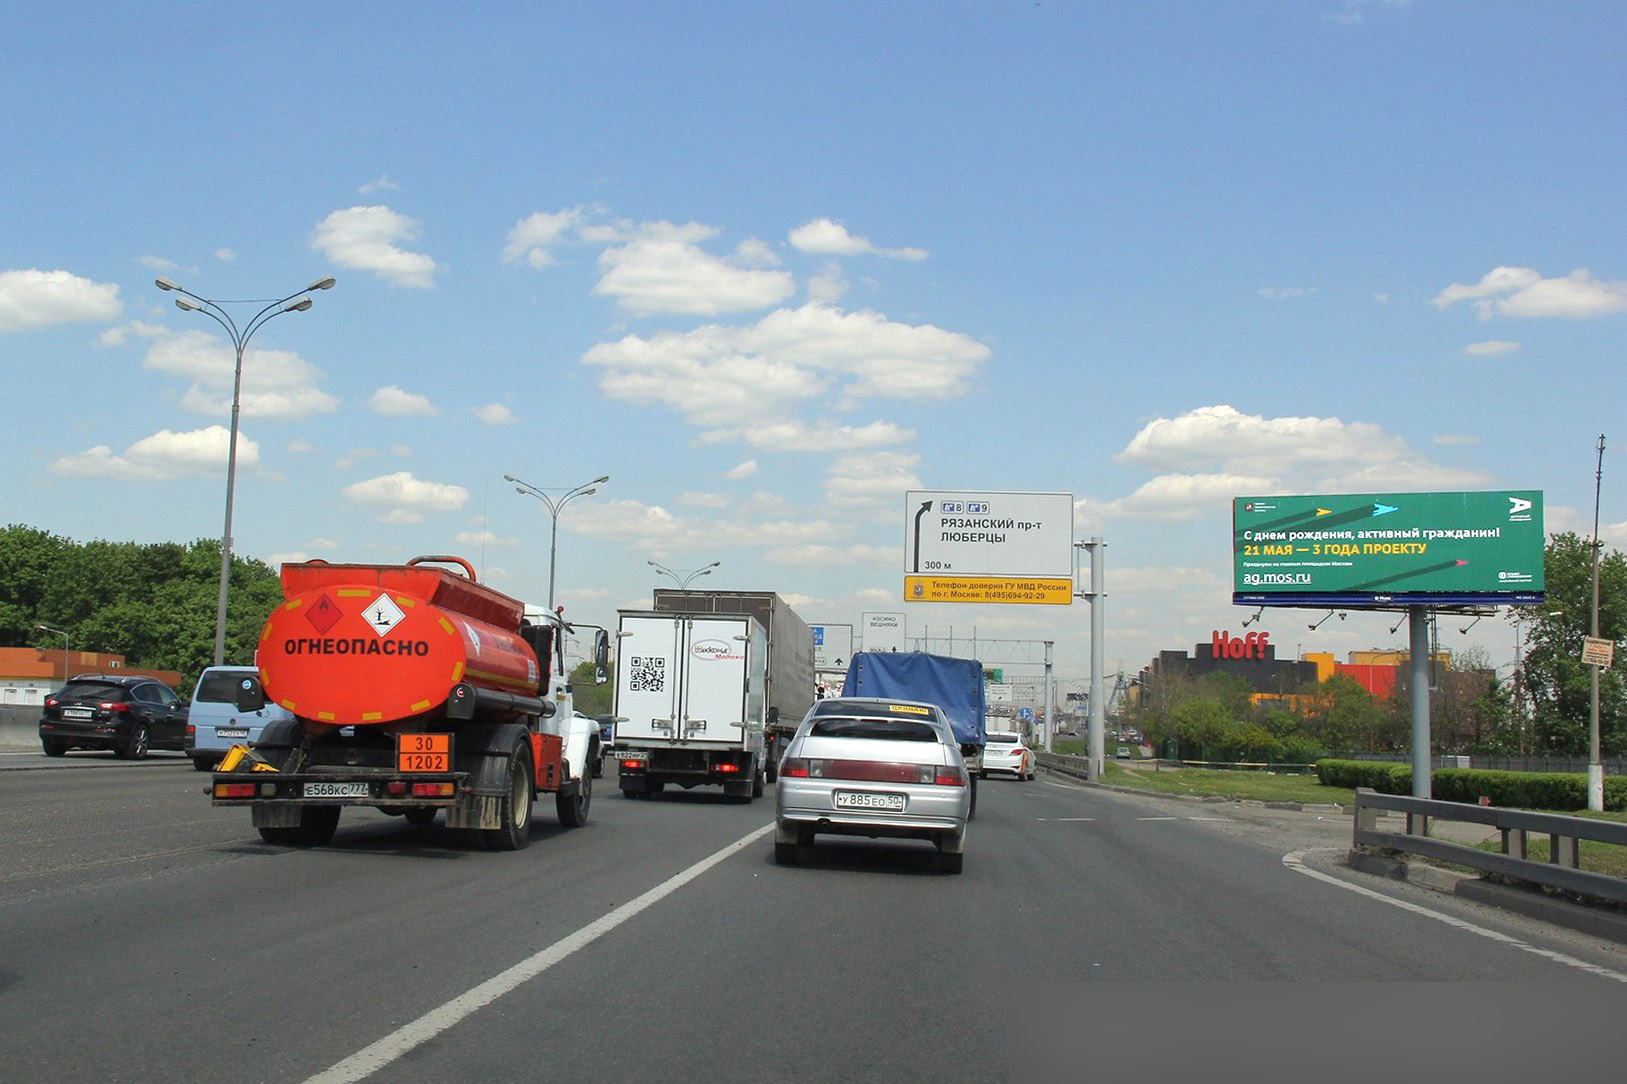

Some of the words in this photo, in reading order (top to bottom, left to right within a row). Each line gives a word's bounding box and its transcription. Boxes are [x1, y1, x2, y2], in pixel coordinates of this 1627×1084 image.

[956, 504, 962, 512] 8
[981, 504, 988, 513] 9
[941, 518, 1014, 529] РЯЗАНСКИЙ
[1017, 522, 1042, 531] пр-т
[941, 532, 1006, 544] ЛЮБЕРЦЫ
[1254, 532, 1286, 541] днем
[1289, 531, 1355, 542] рождения,
[1358, 529, 1419, 540] активный
[1423, 527, 1500, 540] гражданин!
[1244, 545, 1259, 556] 21
[1263, 545, 1293, 555] МАЯ
[1313, 544, 1321, 555] 3
[1325, 543, 1360, 556] ГОДА
[1363, 543, 1427, 555] ПРОЕКТУ
[925, 561, 941, 570] 300
[1243, 573, 1311, 585] ag.mos.ru
[932, 581, 967, 589] Телефон
[1017, 583, 1036, 591] МВД
[985, 592, 1045, 600] 8(495)694-92-29
[284, 638, 429, 656] ОГНЕОПАСНО
[416, 737, 433, 750] 30
[406, 755, 443, 769] 1202
